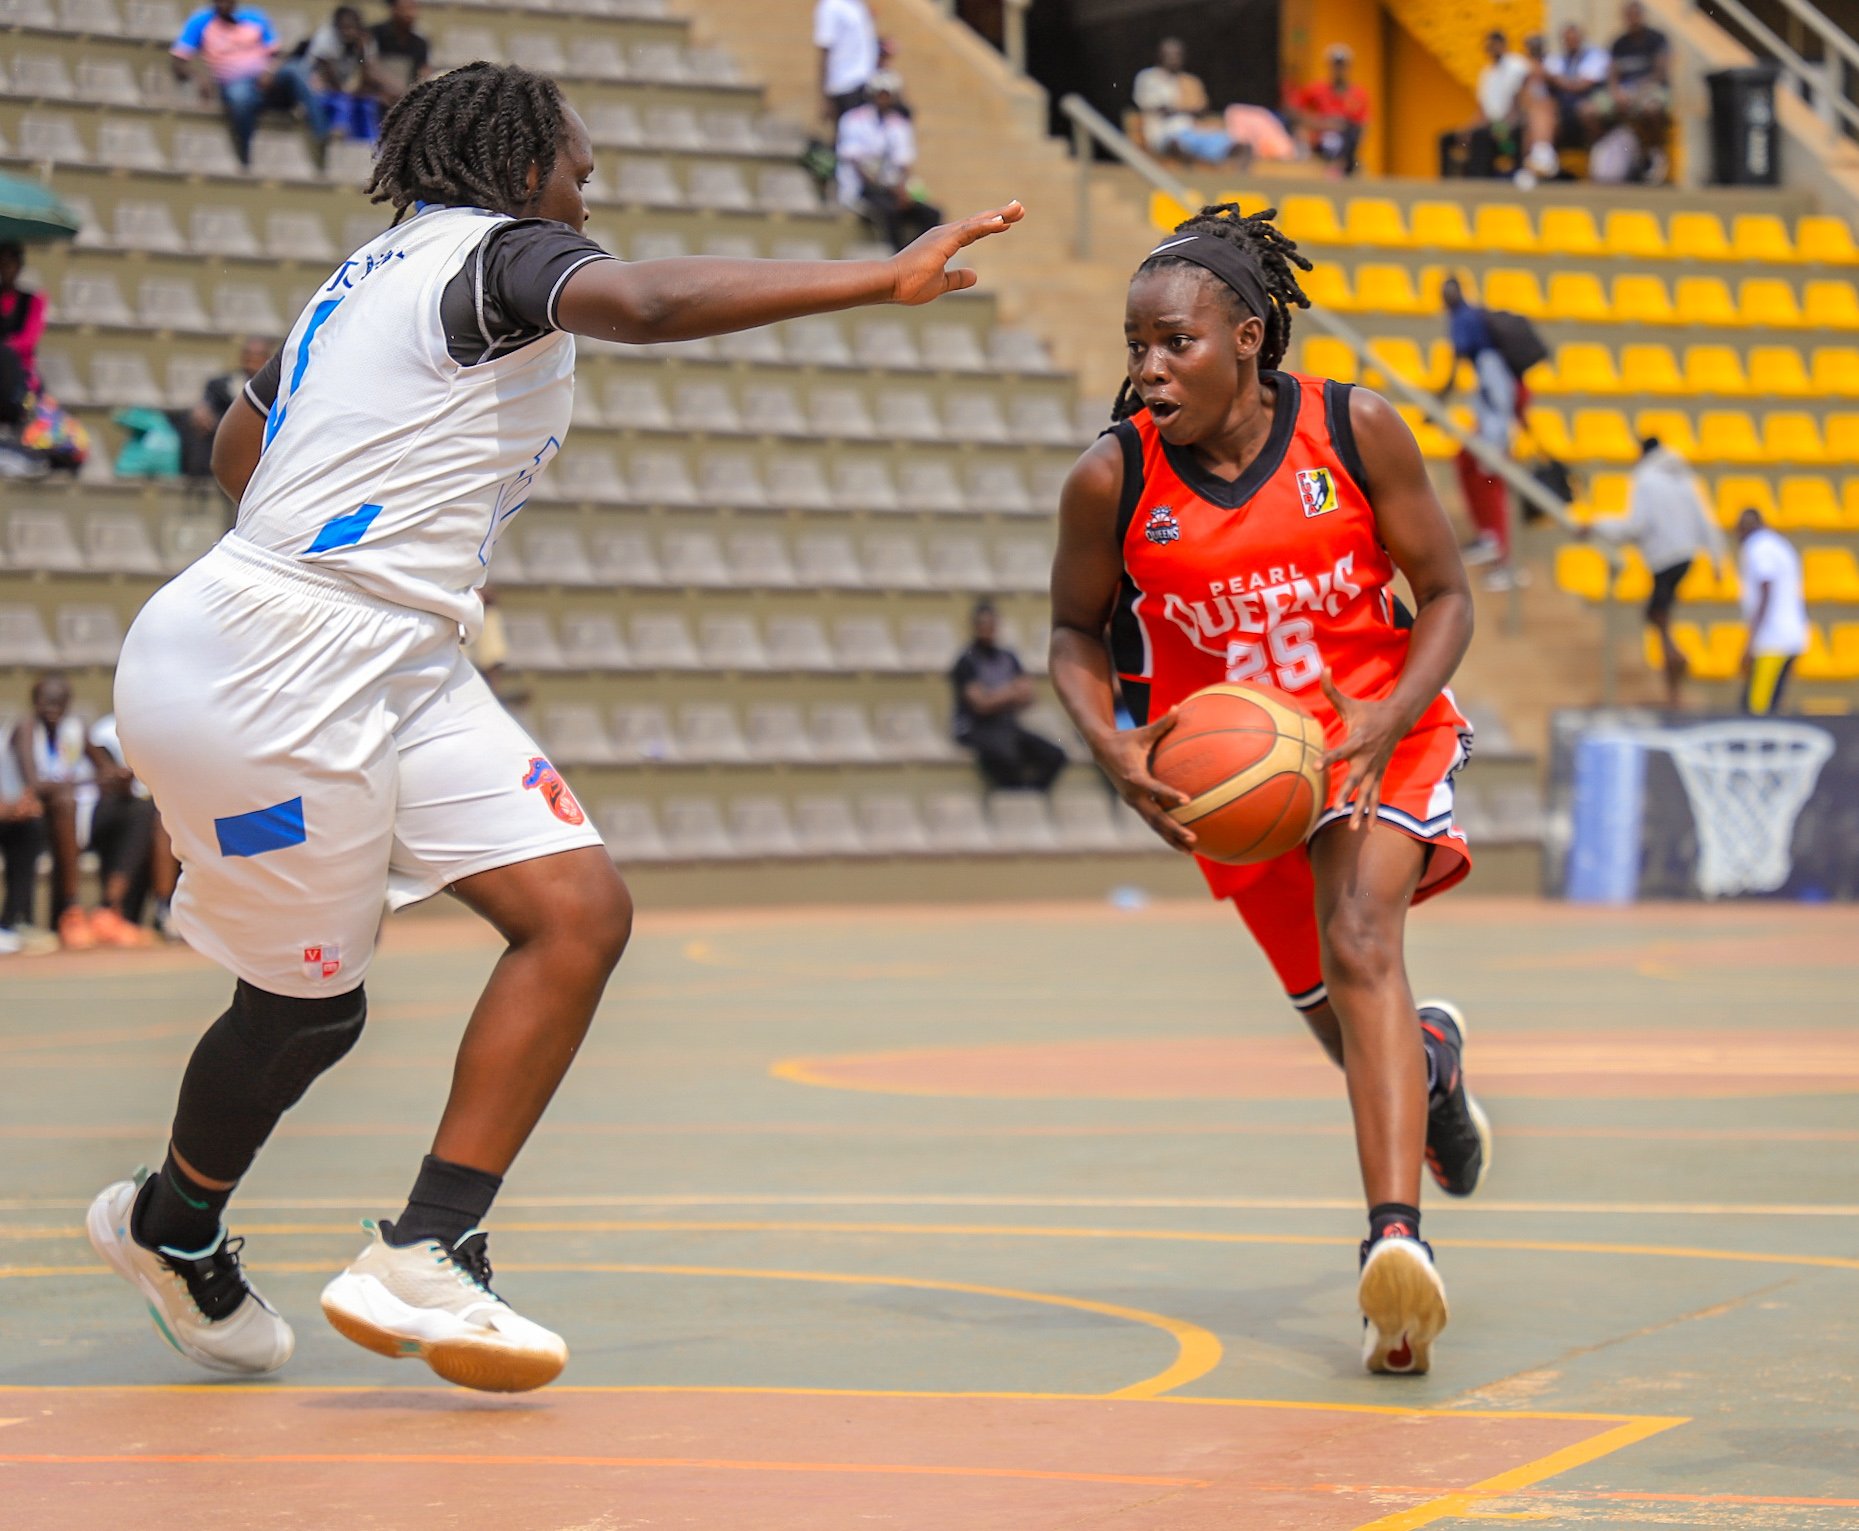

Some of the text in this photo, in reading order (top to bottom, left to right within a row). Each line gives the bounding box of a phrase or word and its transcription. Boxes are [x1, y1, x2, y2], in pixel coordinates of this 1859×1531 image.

[1163, 551, 1361, 659] QUEENS
[1209, 564, 1304, 597] PEARL
[1225, 616, 1325, 693] 25
